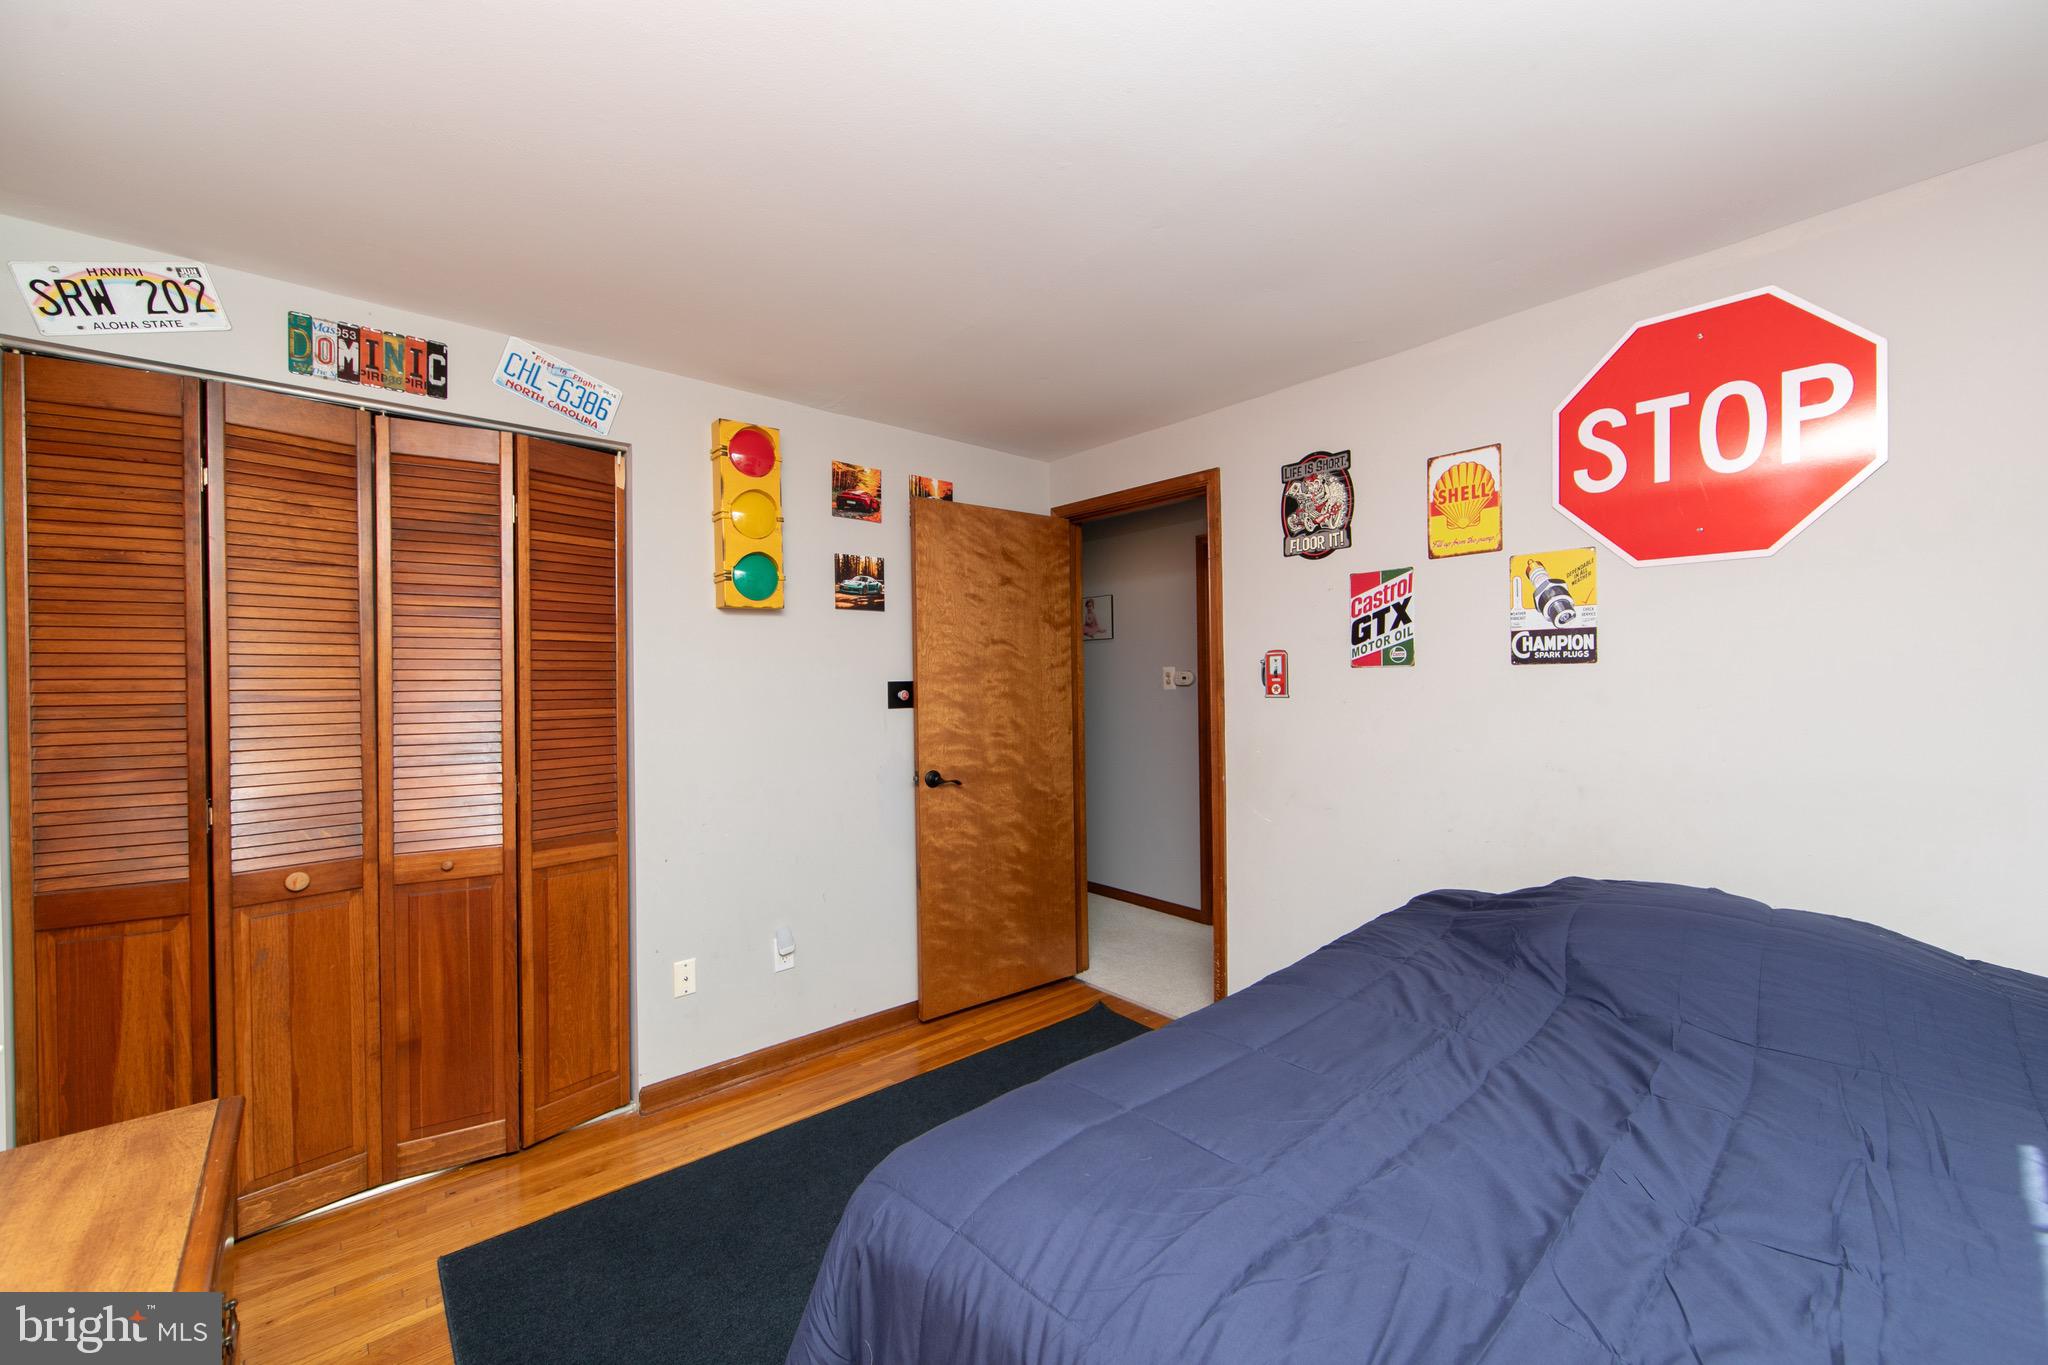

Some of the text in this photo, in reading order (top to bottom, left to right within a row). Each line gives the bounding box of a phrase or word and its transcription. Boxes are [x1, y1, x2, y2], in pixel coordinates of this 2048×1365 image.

[86, 267, 144, 277] HAWAII
[178, 267, 198, 275] JUN
[29, 278, 216, 316] SRW 202
[93, 319, 184, 330] ALOHA STATE
[503, 352, 612, 421] CHL-6386
[505, 379, 599, 429] NORTH CAROLINA
[1573, 362, 1854, 494] STOP
[1284, 466, 1302, 480] LIFE
[1304, 463, 1314, 475] IS
[1438, 482, 1490, 505] SHELL
[1289, 530, 1344, 554] FLOOR IT!
[1351, 572, 1413, 619] Castrol
[1351, 596, 1413, 646] GTX
[1351, 626, 1413, 658] MOTOR OIL
[1511, 631, 1595, 659] CHAMPION
[1534, 650, 1590, 659] SPARK PLUGS
